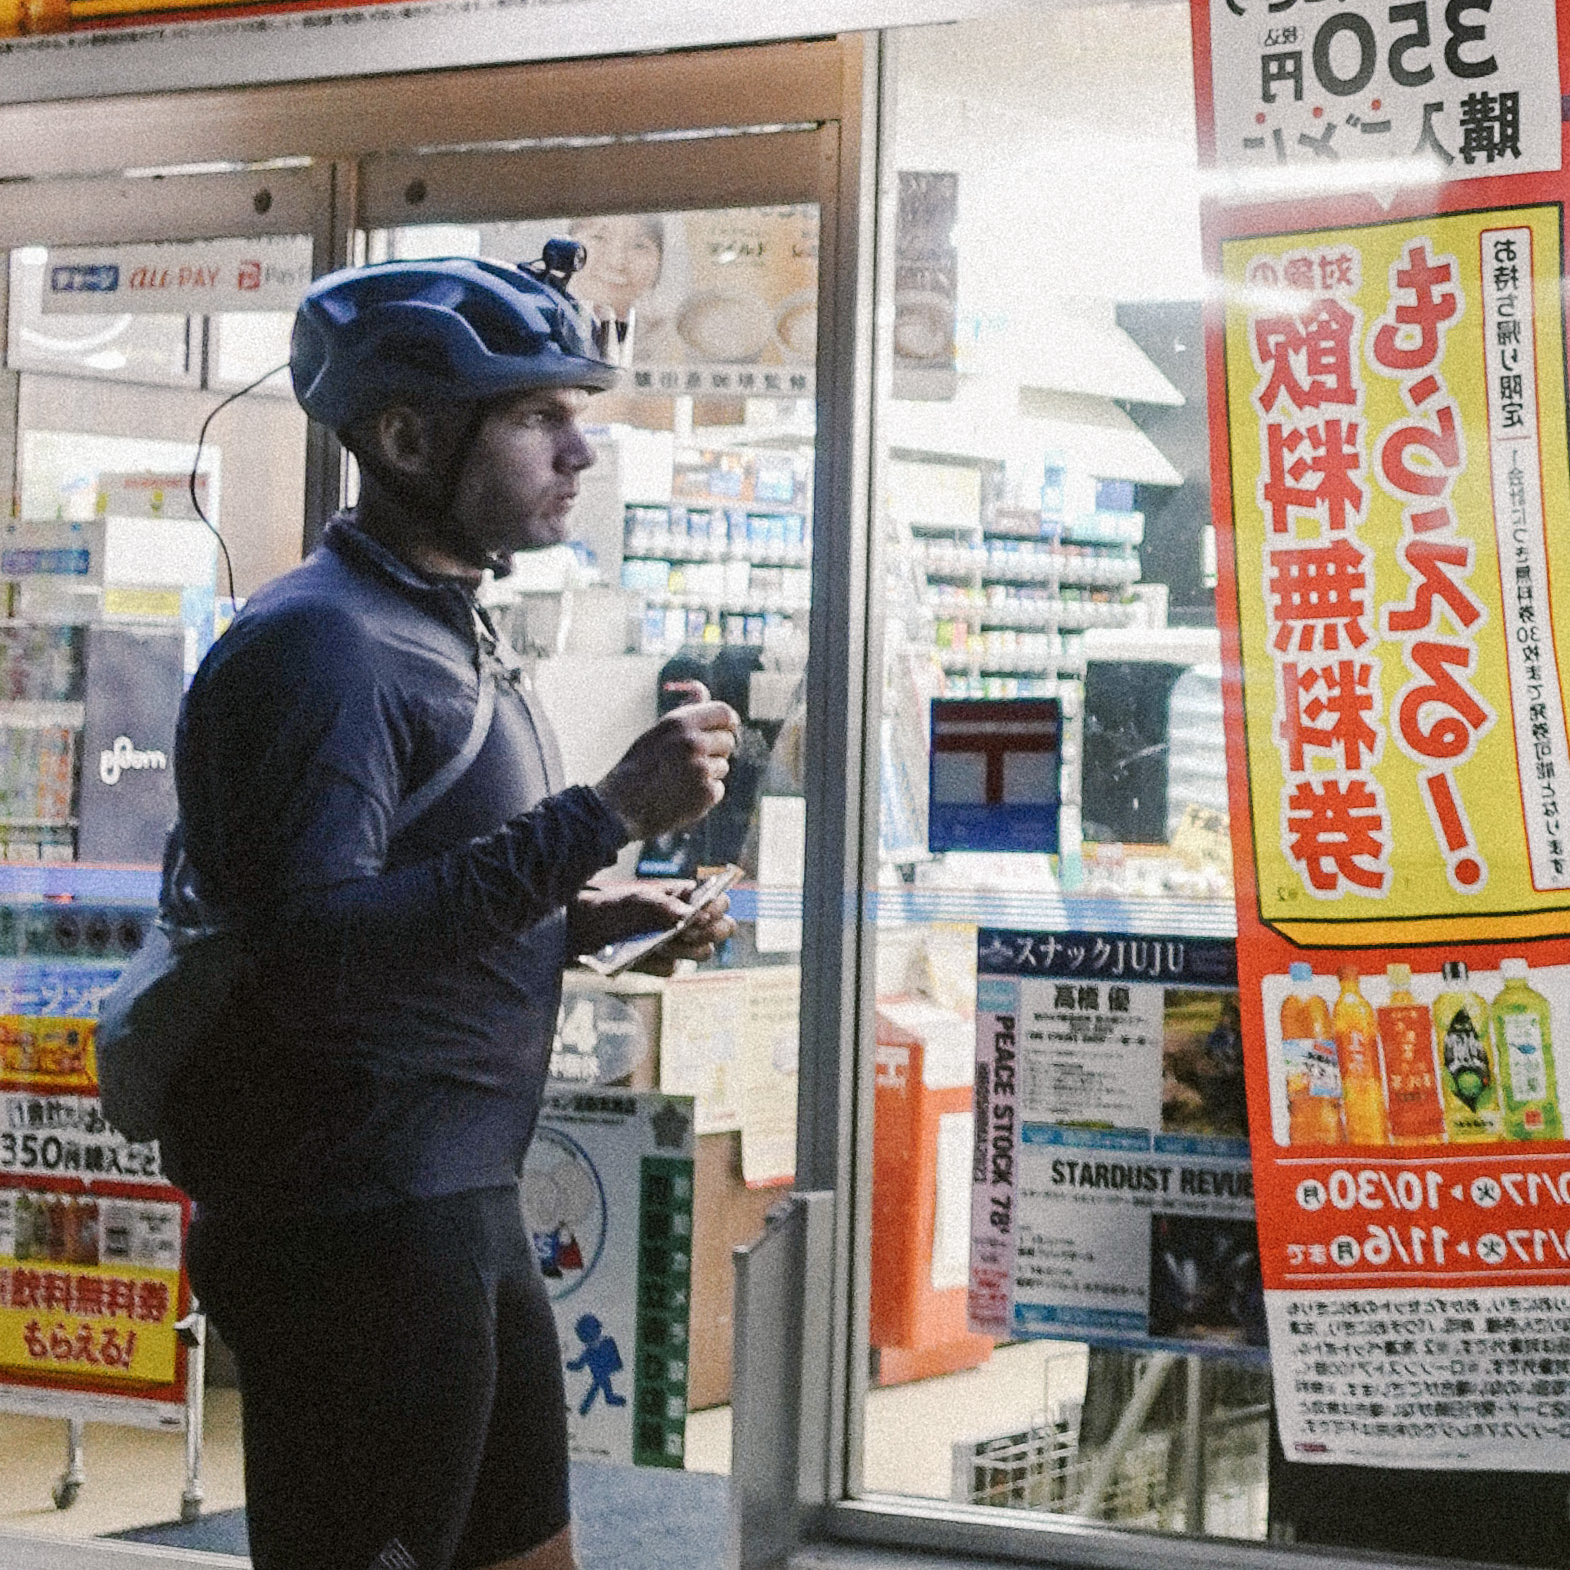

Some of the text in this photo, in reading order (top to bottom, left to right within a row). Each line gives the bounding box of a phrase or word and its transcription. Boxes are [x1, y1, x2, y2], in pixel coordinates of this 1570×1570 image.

[993, 1014, 1016, 1097] PEACE
[990, 1103, 1015, 1186] STOCK
[1051, 1160, 1172, 1194] STARDUST
